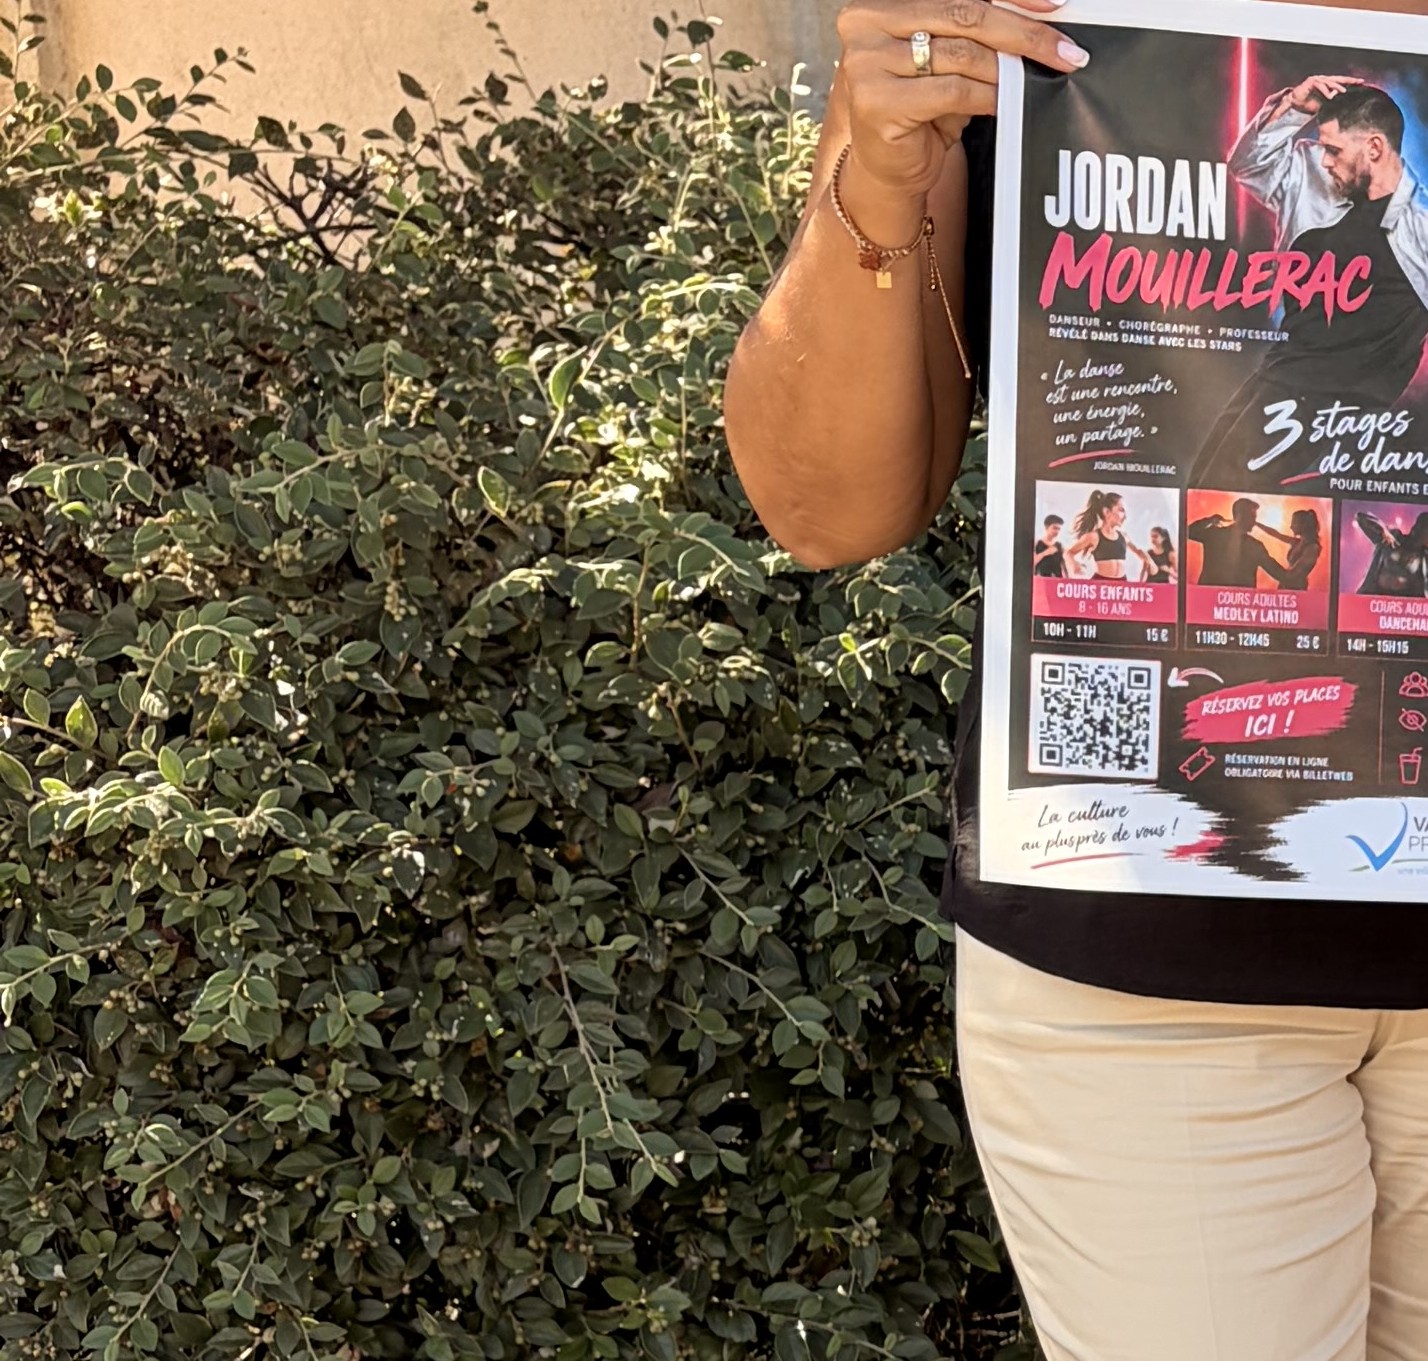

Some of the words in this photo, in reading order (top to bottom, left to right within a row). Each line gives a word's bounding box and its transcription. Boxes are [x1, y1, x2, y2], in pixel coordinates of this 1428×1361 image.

[1044, 149, 1228, 241] JORDAN
[1036, 171, 1374, 327] MOUILLERAC
[1054, 359, 1076, 385] La
[1079, 358, 1125, 379] danse
[1045, 383, 1069, 405] est
[1070, 387, 1100, 402] une
[1102, 368, 1178, 398] rencontre,
[1053, 409, 1083, 424] une
[1086, 402, 1145, 427] énergie,
[1055, 433, 1077, 446] un
[1080, 419, 1145, 454] partage.
[1247, 399, 1304, 471] 3
[1309, 400, 1414, 457] stages
[1318, 440, 1355, 475] de
[1329, 477, 1363, 491] POUR
[1366, 479, 1420, 495] ENFANTS
[1056, 582, 1097, 600] COURS
[1100, 585, 1154, 602] ENFANTS
[1217, 591, 1251, 606] COURS
[1252, 593, 1297, 608] ADULTES
[1213, 606, 1258, 622] MEDLEY
[1259, 609, 1299, 625] LATINO
[1369, 599, 1403, 615] COURS
[1043, 622, 1065, 637] 10H
[1076, 624, 1097, 639] 11H
[1146, 627, 1159, 642] 15
[1160, 628, 1169, 642] €
[1195, 630, 1228, 645] 11H30
[1238, 632, 1270, 647] 12H45
[1296, 635, 1310, 649] 25
[1312, 635, 1320, 650] €
[1347, 638, 1367, 652] 14H
[1377, 639, 1409, 654] 15H15
[1201, 694, 1266, 720] RÉSERVEZ
[1267, 690, 1291, 707] VOS
[1293, 685, 1341, 705] PLACES
[1244, 713, 1277, 738] ICI
[1283, 709, 1295, 734] !
[1037, 804, 1061, 828] La
[1067, 799, 1130, 828] culture
